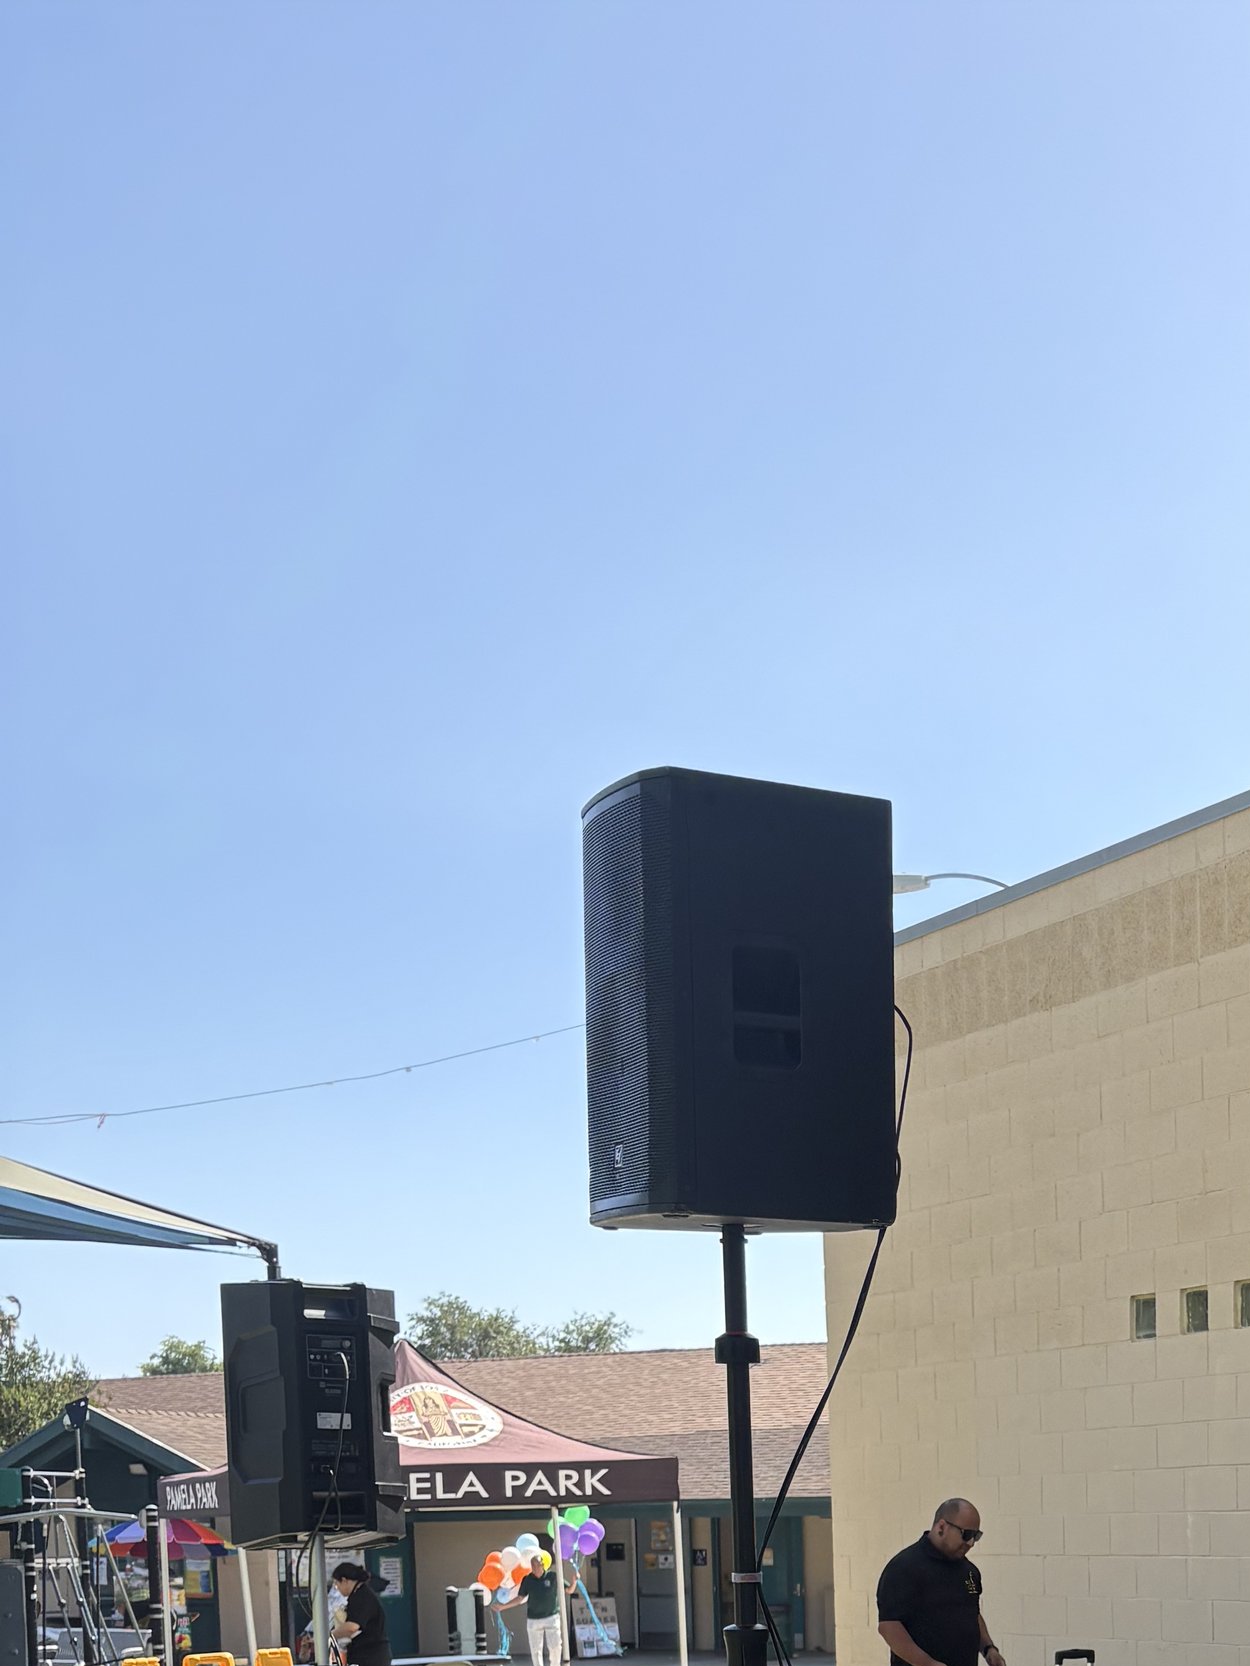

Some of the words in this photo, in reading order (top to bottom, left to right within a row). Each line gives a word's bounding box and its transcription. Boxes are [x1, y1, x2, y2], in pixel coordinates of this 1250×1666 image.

[165, 1483, 196, 1511] PAMELA
[195, 1481, 219, 1509] PARK
[408, 1470, 489, 1500] ELA
[504, 1468, 612, 1498] PARK
